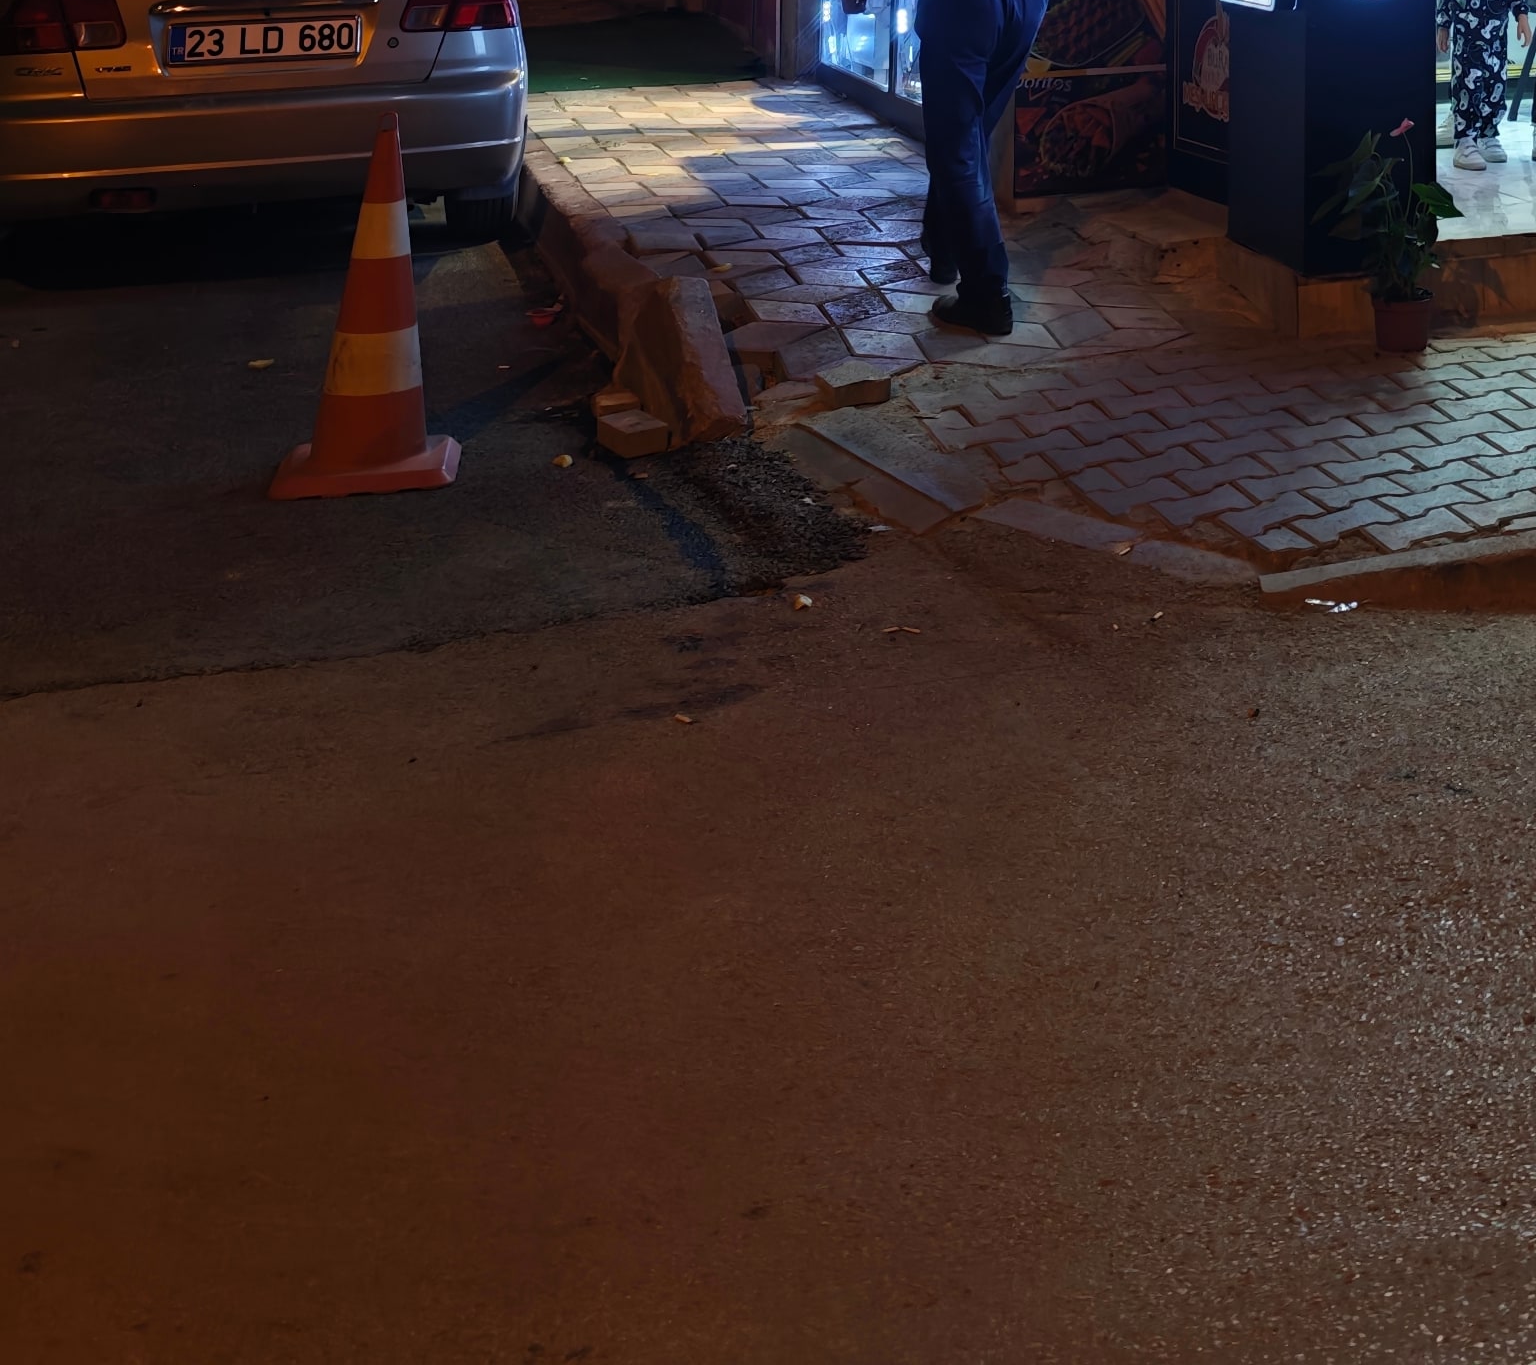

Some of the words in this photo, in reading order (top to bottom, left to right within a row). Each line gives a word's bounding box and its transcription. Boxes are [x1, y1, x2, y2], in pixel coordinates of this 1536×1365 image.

[186, 29, 224, 58] 23
[239, 26, 284, 55] LD
[298, 22, 355, 52] 680
